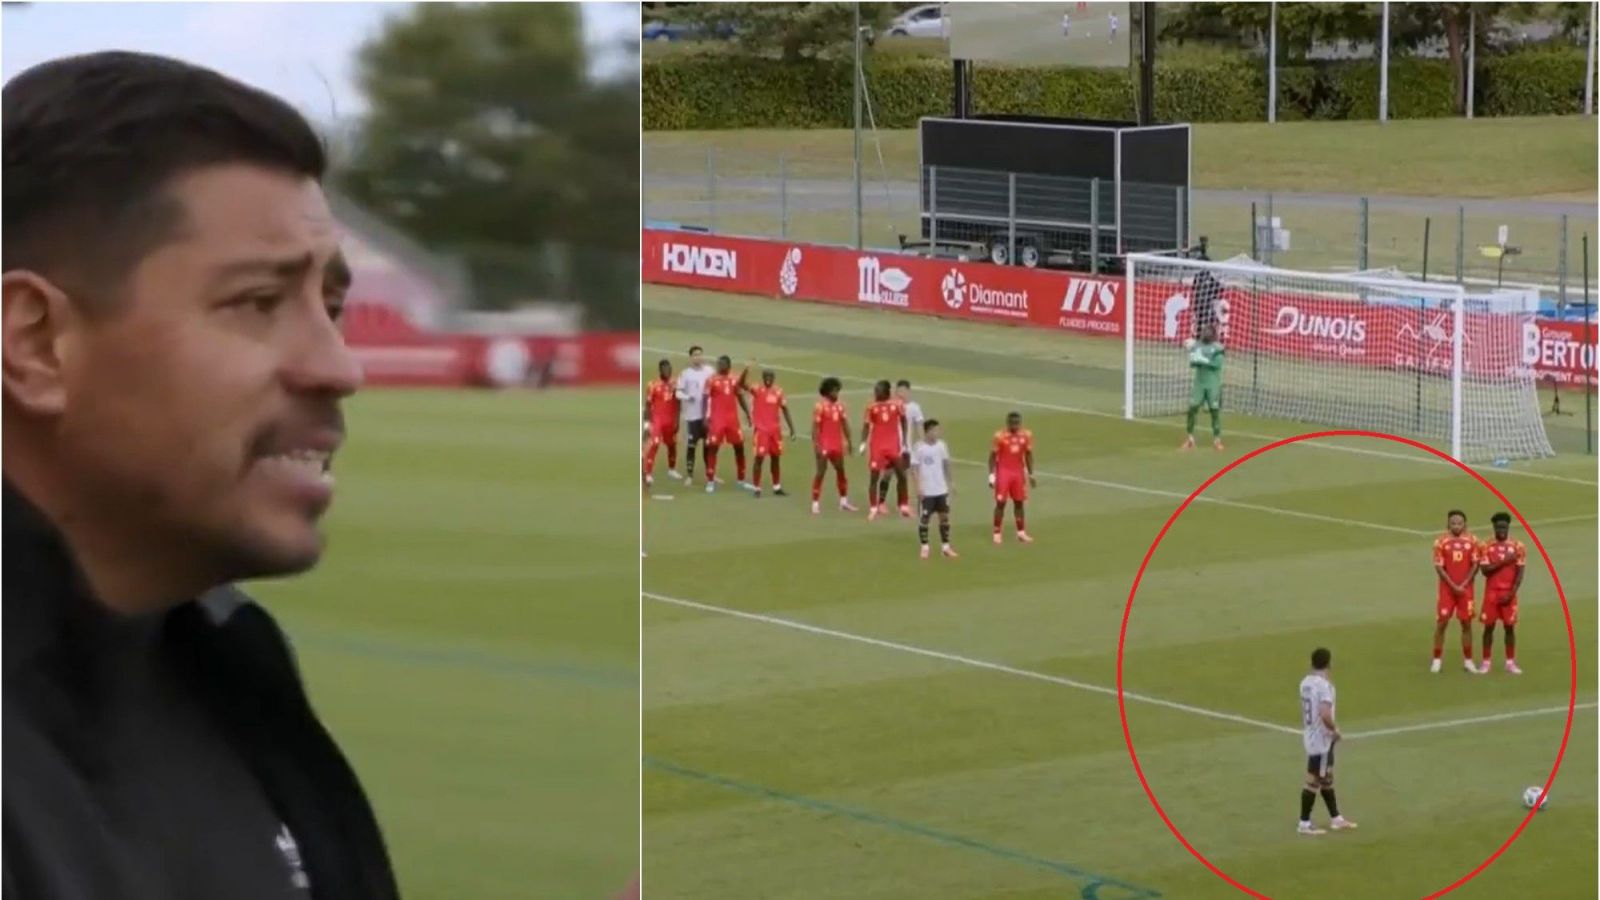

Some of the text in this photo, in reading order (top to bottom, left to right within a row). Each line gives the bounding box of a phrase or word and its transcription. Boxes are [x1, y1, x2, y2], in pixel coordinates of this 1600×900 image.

[663, 242, 737, 279] HOWDEN
[969, 283, 1028, 309] Diamant
[1060, 278, 1119, 315] ITS
[1453, 550, 1464, 562] 10
